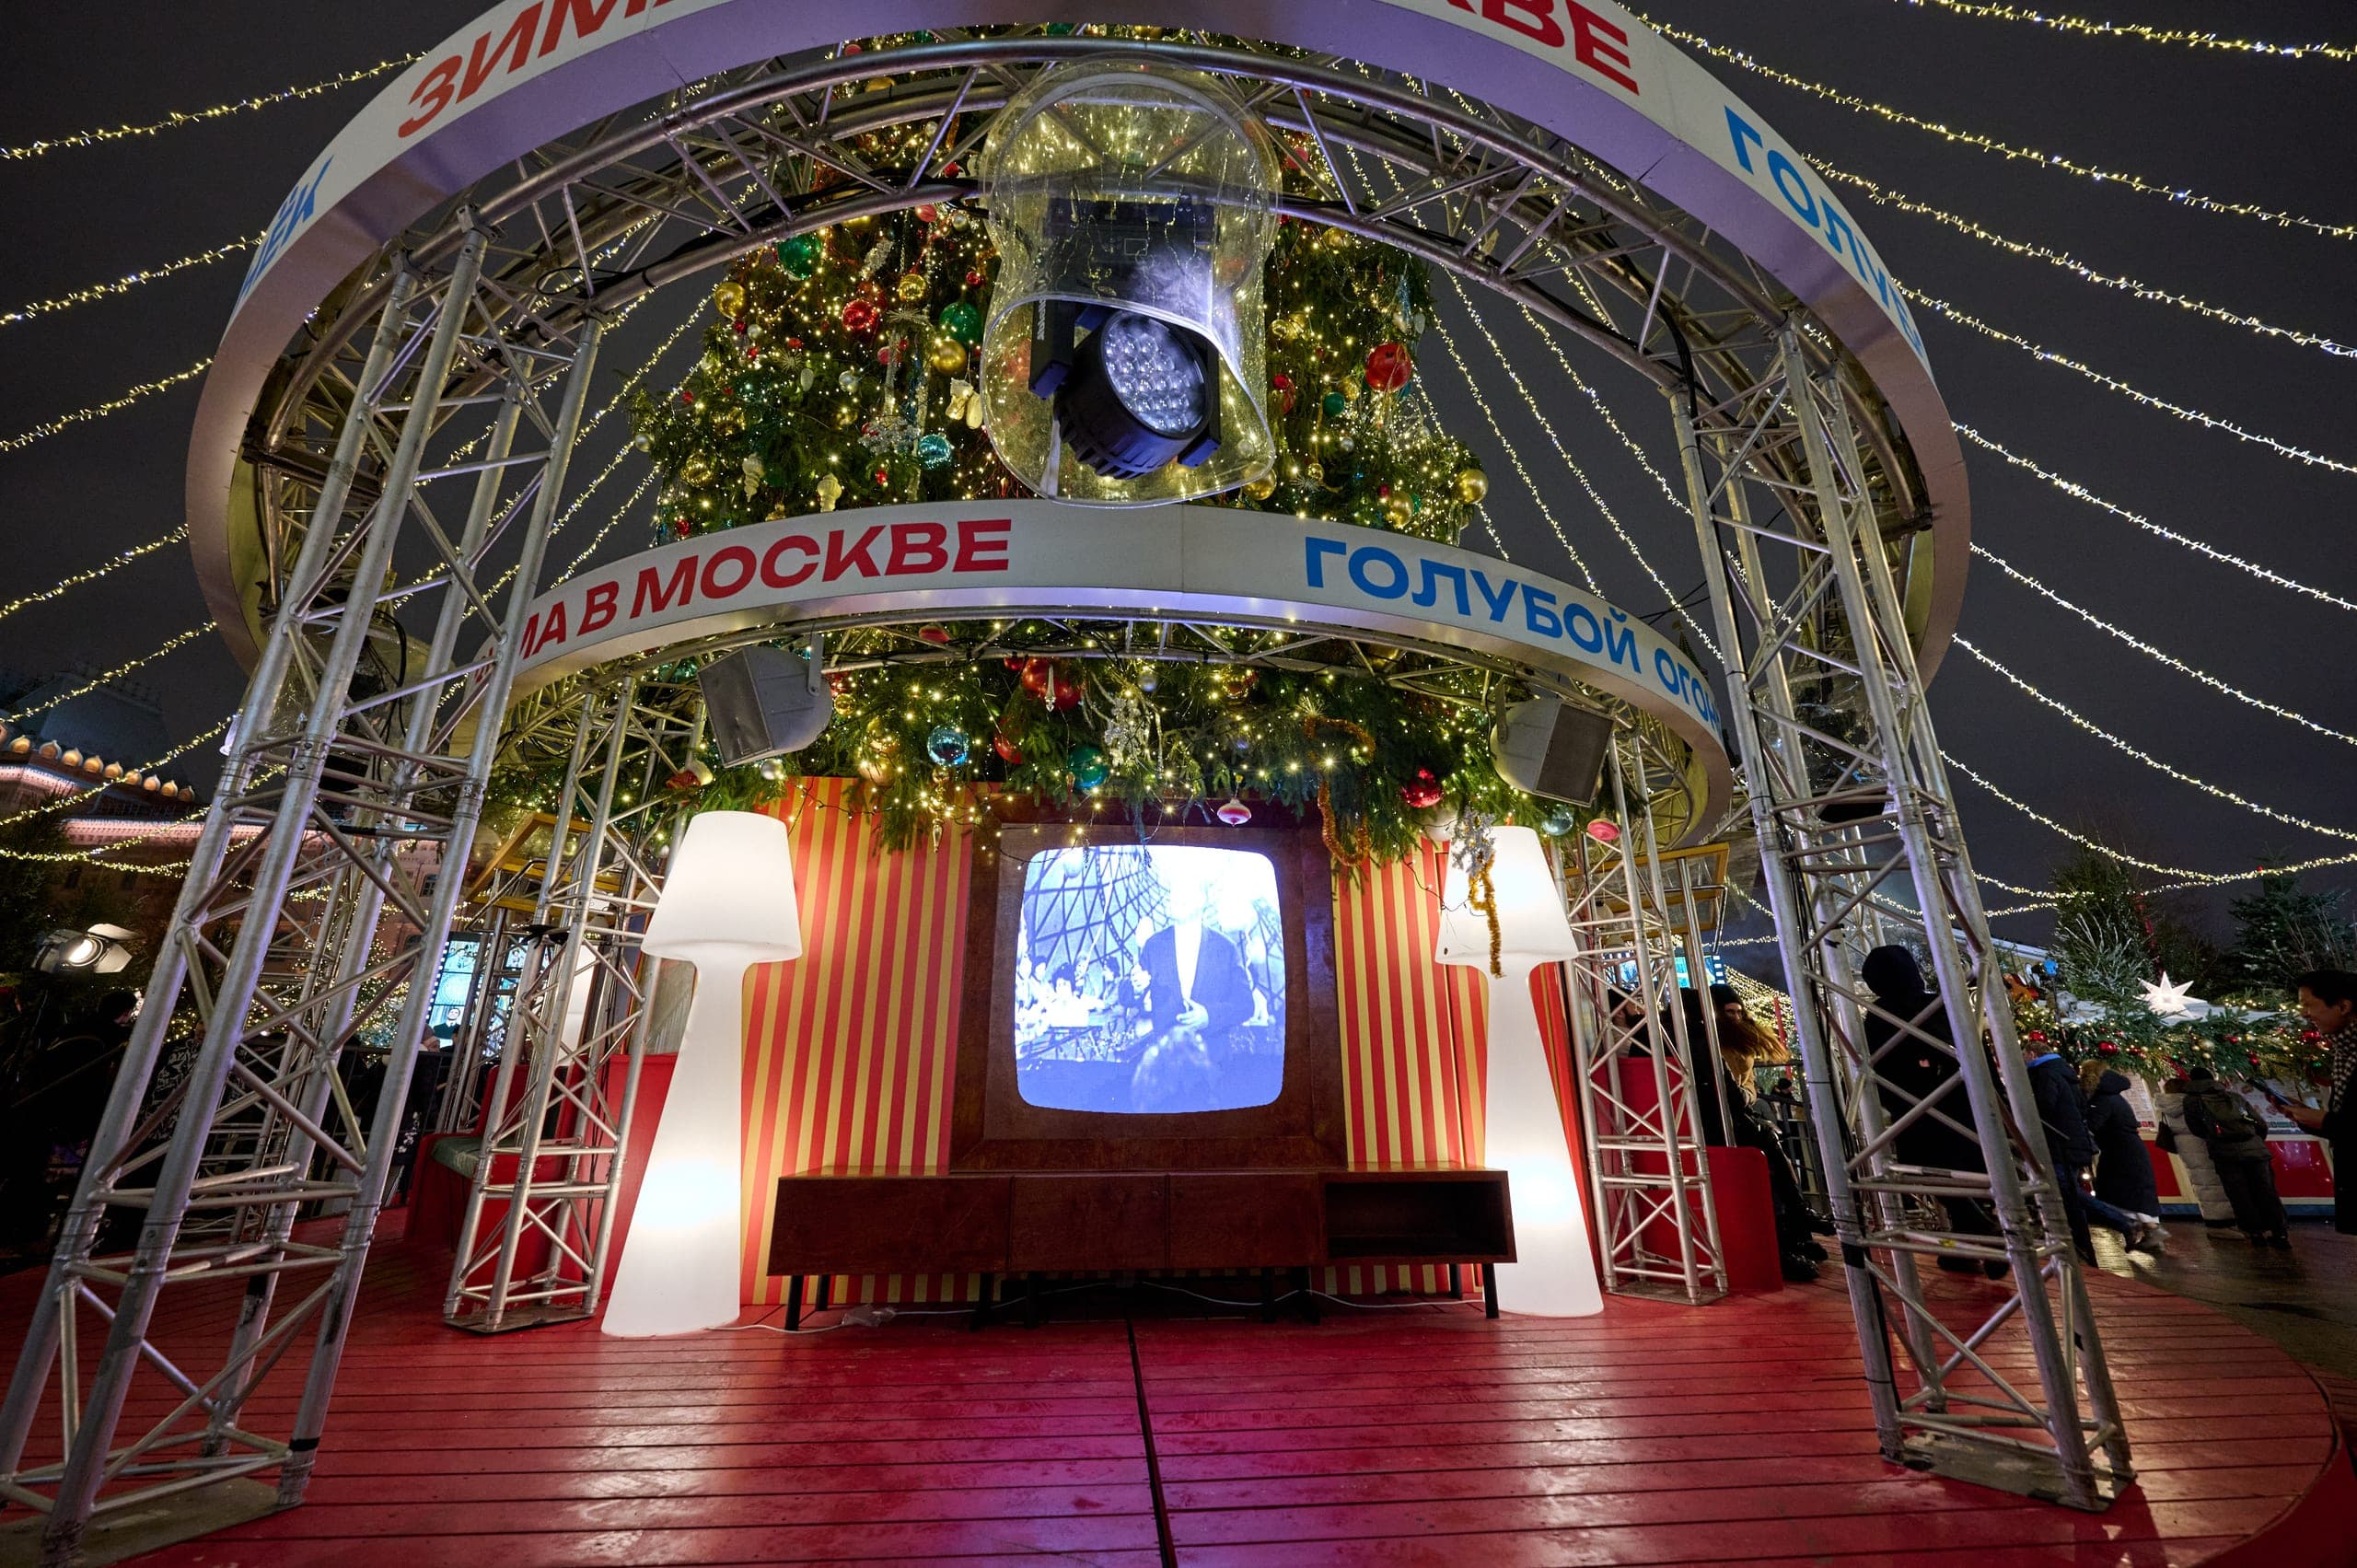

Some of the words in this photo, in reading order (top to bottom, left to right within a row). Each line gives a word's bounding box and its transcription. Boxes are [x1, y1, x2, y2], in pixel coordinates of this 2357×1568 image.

[398, 0, 678, 138] ЗИМ
[1446, 0, 1641, 96] ВЕ
[1724, 105, 1925, 357] ГОЛУБ
[576, 580, 620, 637] В
[630, 519, 1012, 619] МОСКВЕ
[1306, 537, 1642, 674] ГОЛУБОЙ
[1654, 647, 1722, 736] ОГОН
